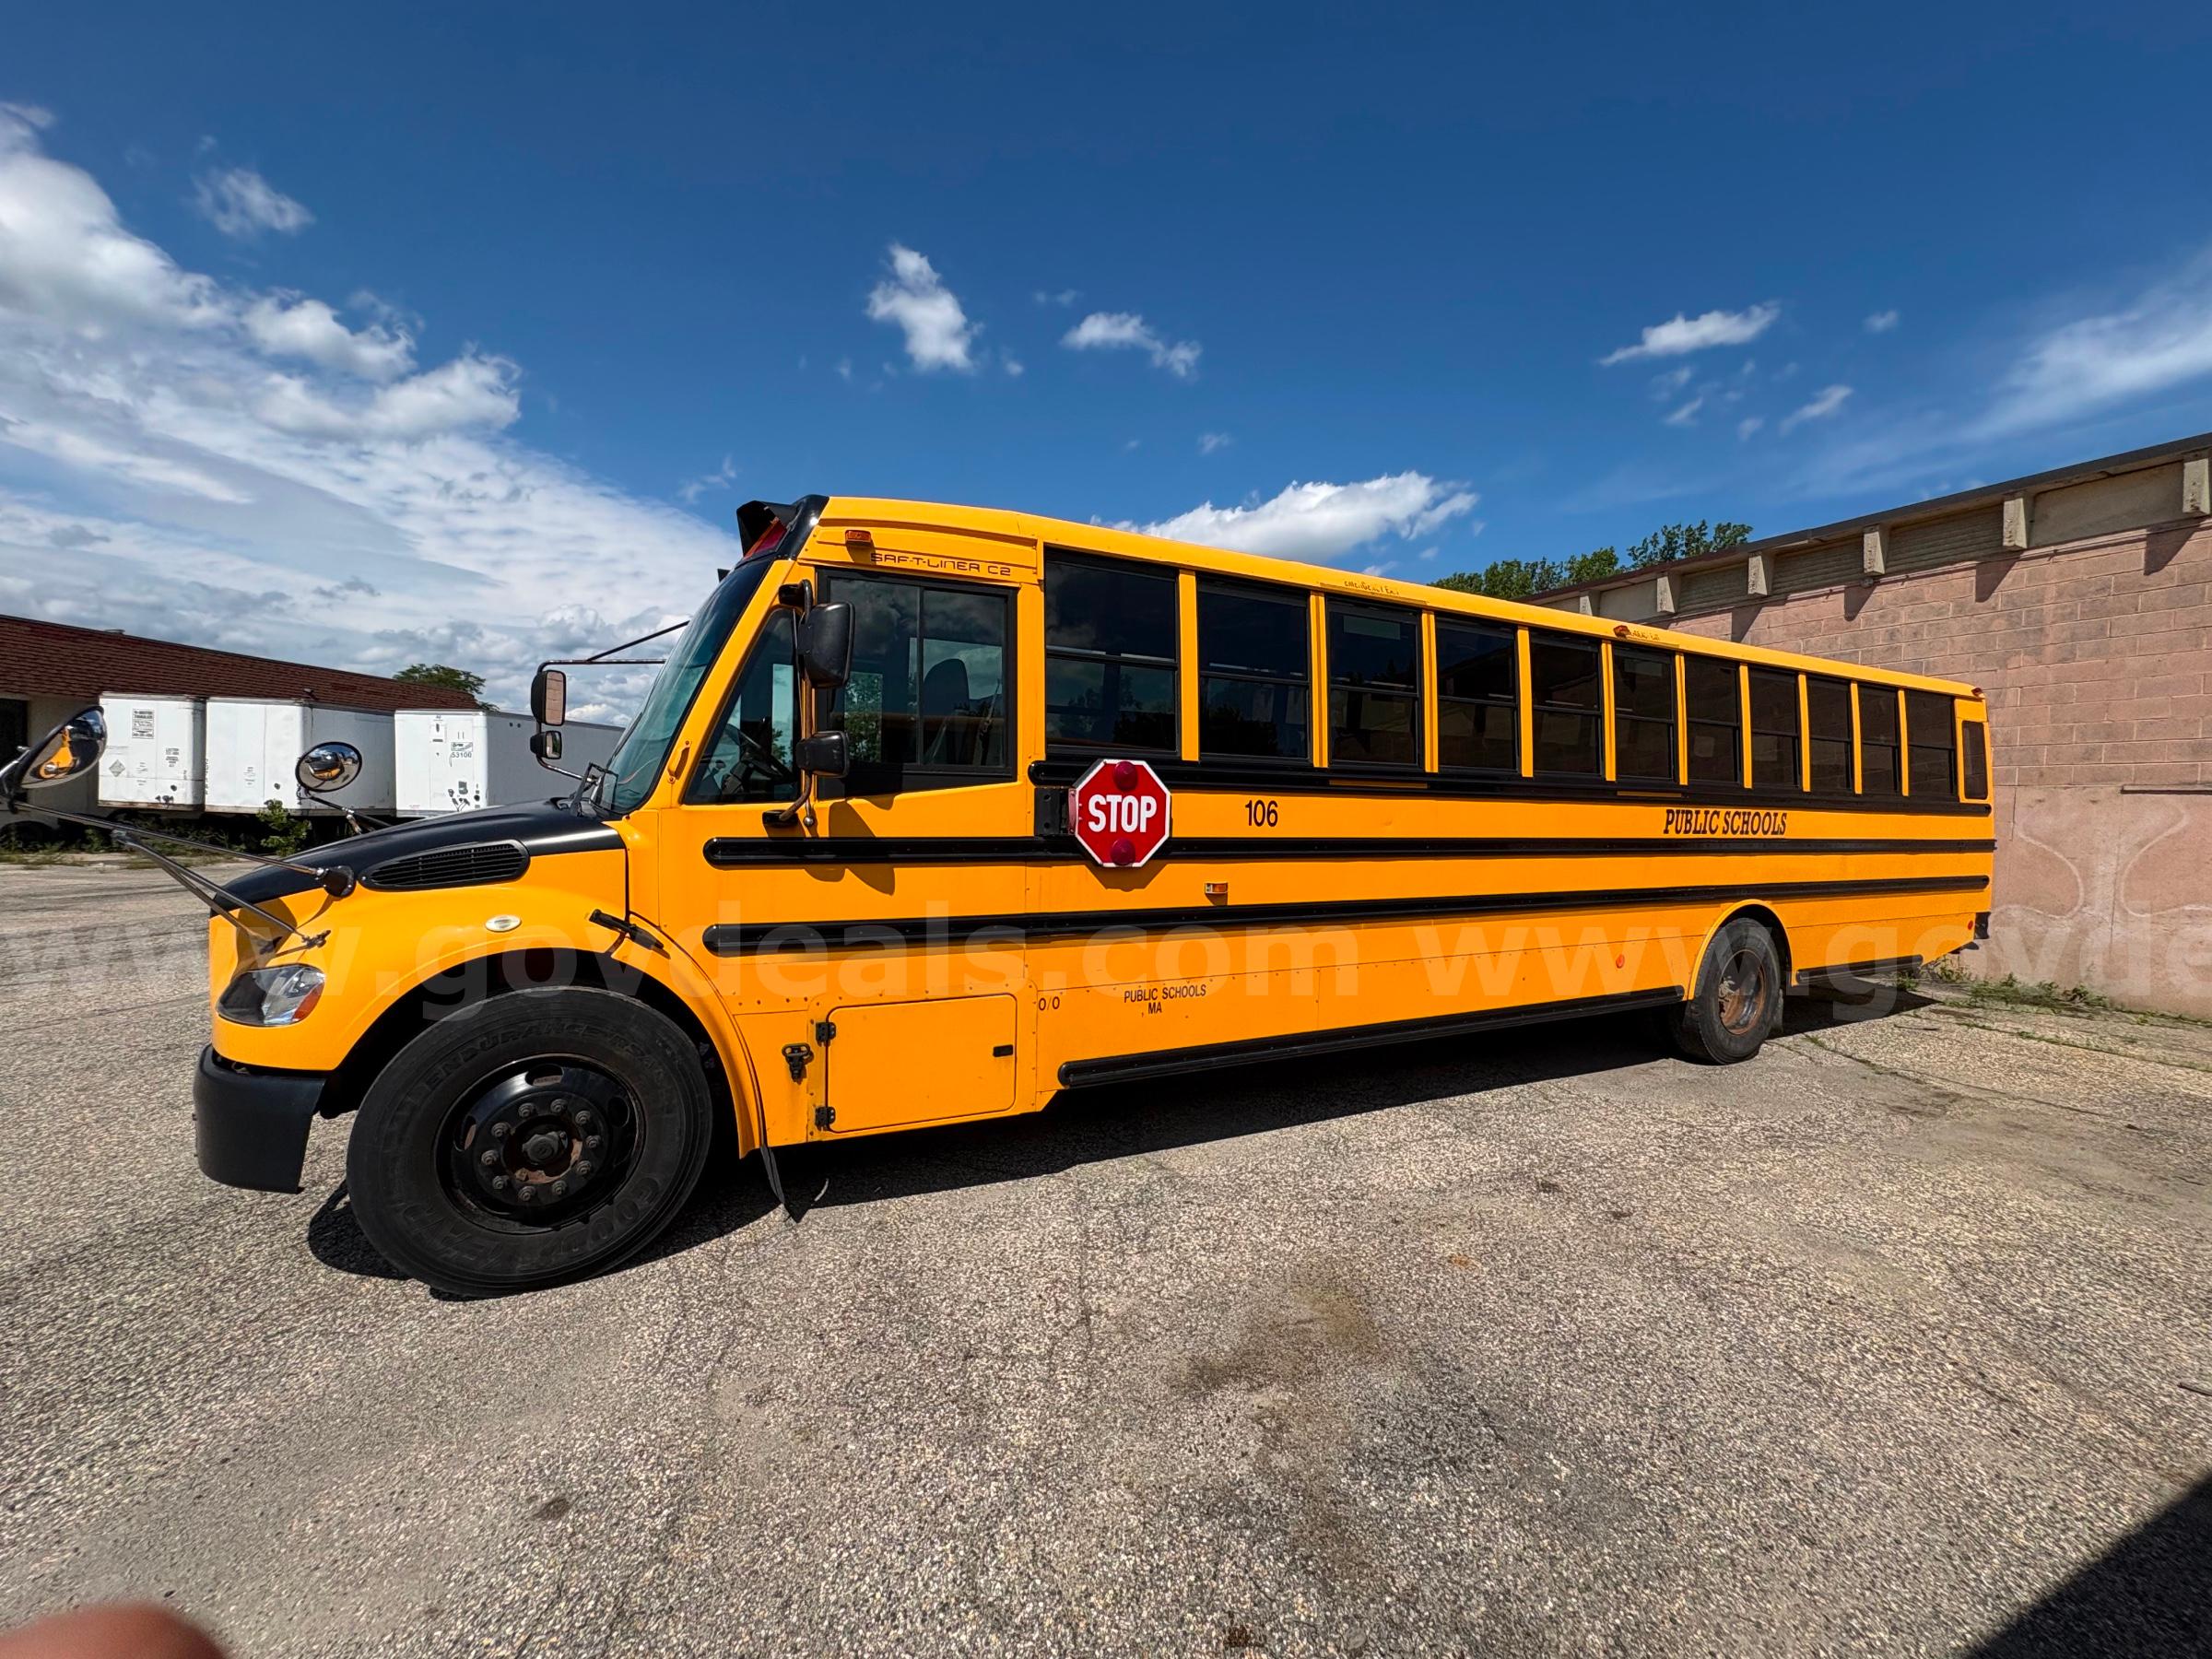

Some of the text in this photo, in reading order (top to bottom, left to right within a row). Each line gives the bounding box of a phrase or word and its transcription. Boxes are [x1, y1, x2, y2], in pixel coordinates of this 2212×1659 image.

[987, 565, 1011, 577] C2
[1088, 794, 1157, 833] STOP
[1245, 800, 1278, 828] 106
[1663, 808, 1787, 836] PUBLIC SCHOOLS
[1124, 984, 1206, 1003] PUBLIC SCHOOLS
[1147, 1002, 1162, 1015] MA
